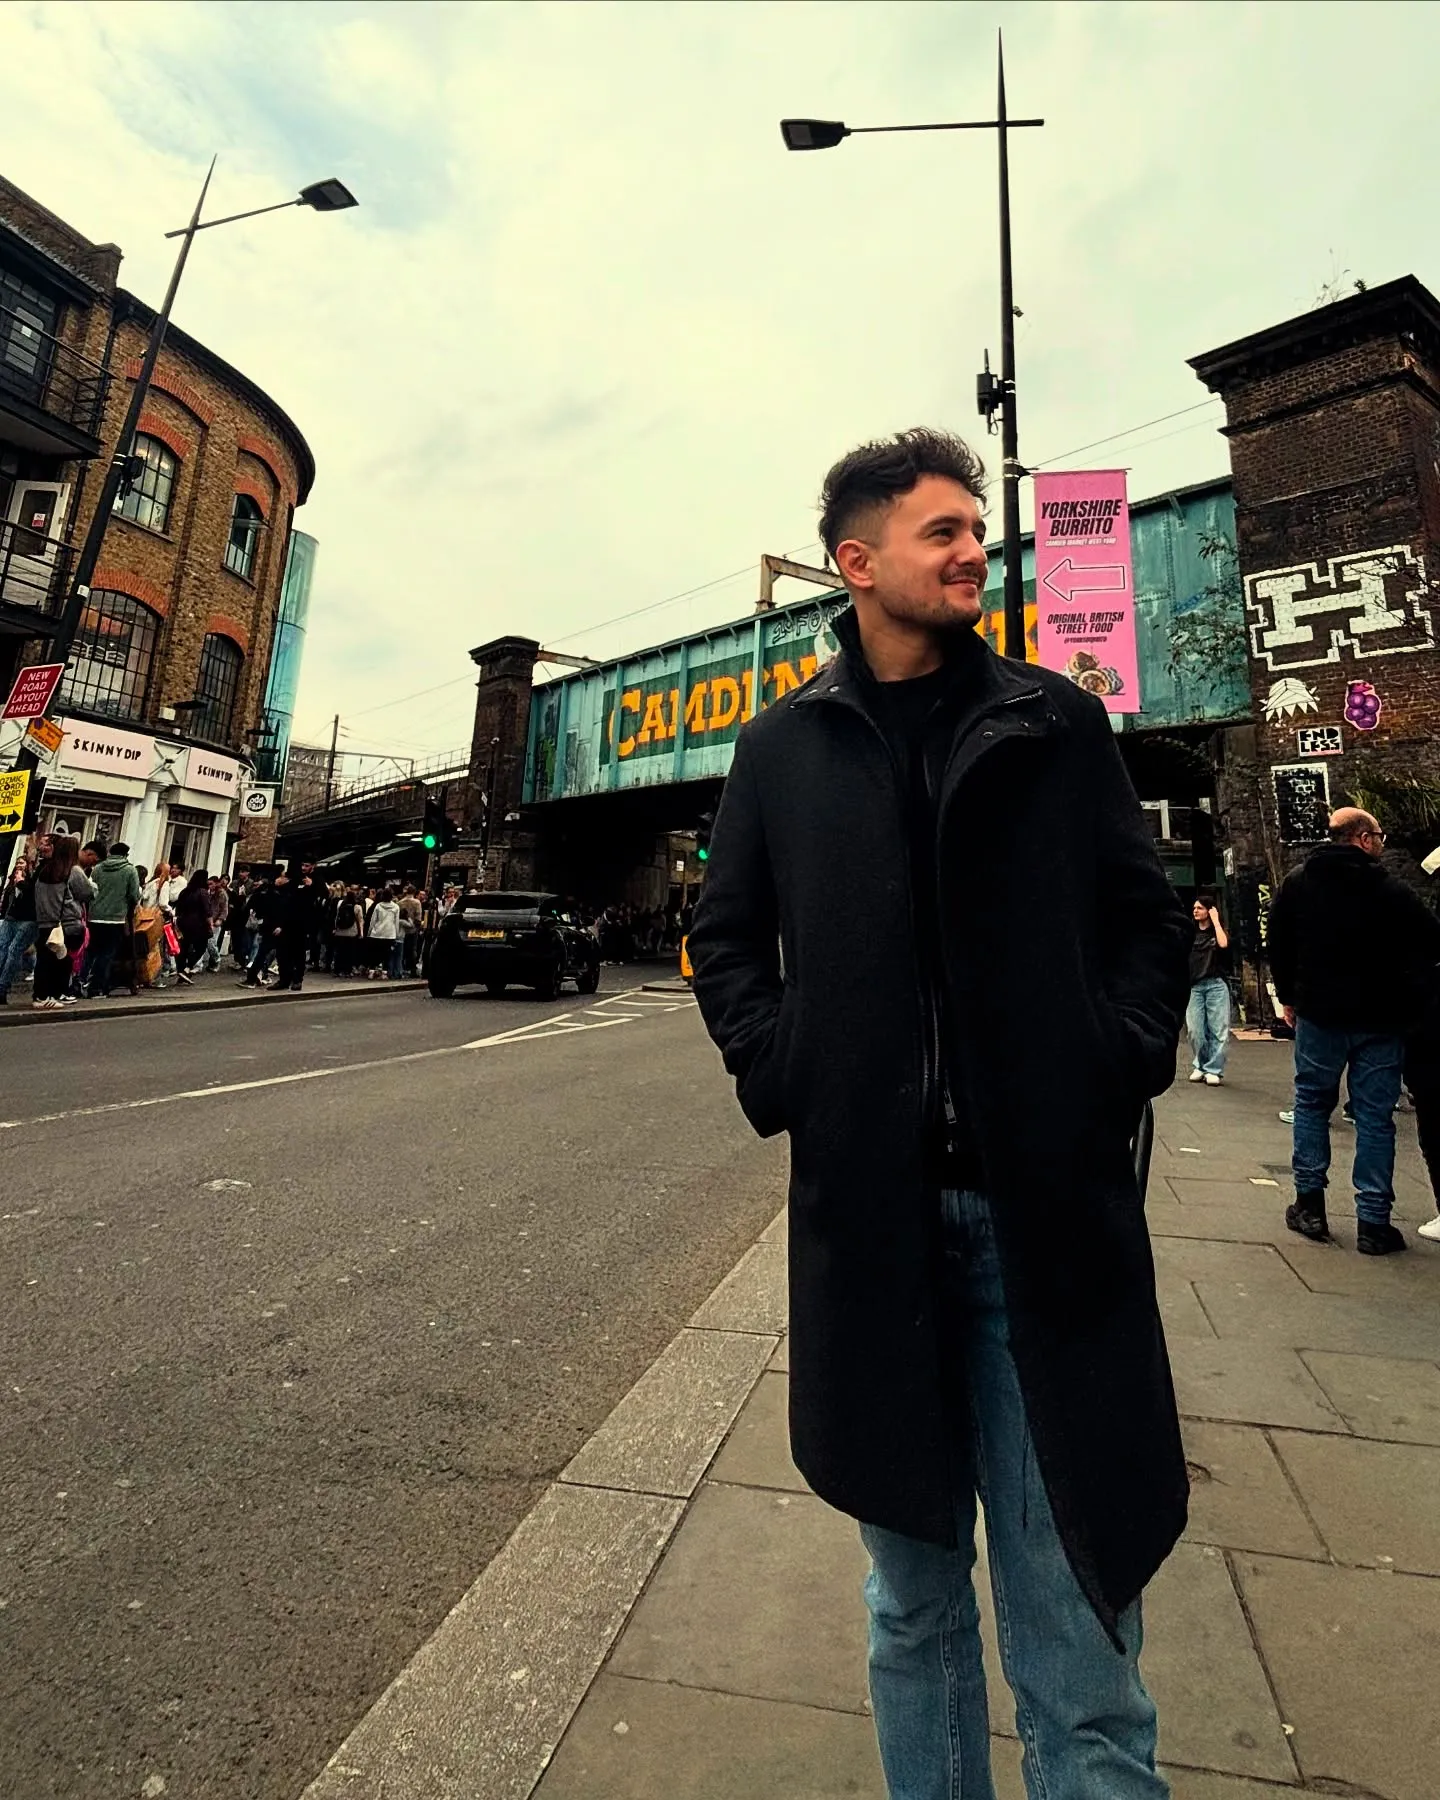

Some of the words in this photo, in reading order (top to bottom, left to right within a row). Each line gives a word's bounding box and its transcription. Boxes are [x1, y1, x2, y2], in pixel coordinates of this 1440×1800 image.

[1041, 499, 1122, 519] YORKSHIRE
[1050, 518, 1113, 536] BURRITO
[1047, 613, 1086, 624] ORIGINAL
[1089, 611, 1125, 623] BRITISH
[1056, 622, 1088, 634] STREET
[1089, 622, 1114, 633] FOOD
[28, 671, 50, 681] NEW
[21, 682, 47, 692] ROAD
[12, 692, 48, 703] LAYOUT
[8, 703, 40, 713] AHEAD
[1299, 728, 1339, 741] END
[1300, 740, 1340, 753] LESS
